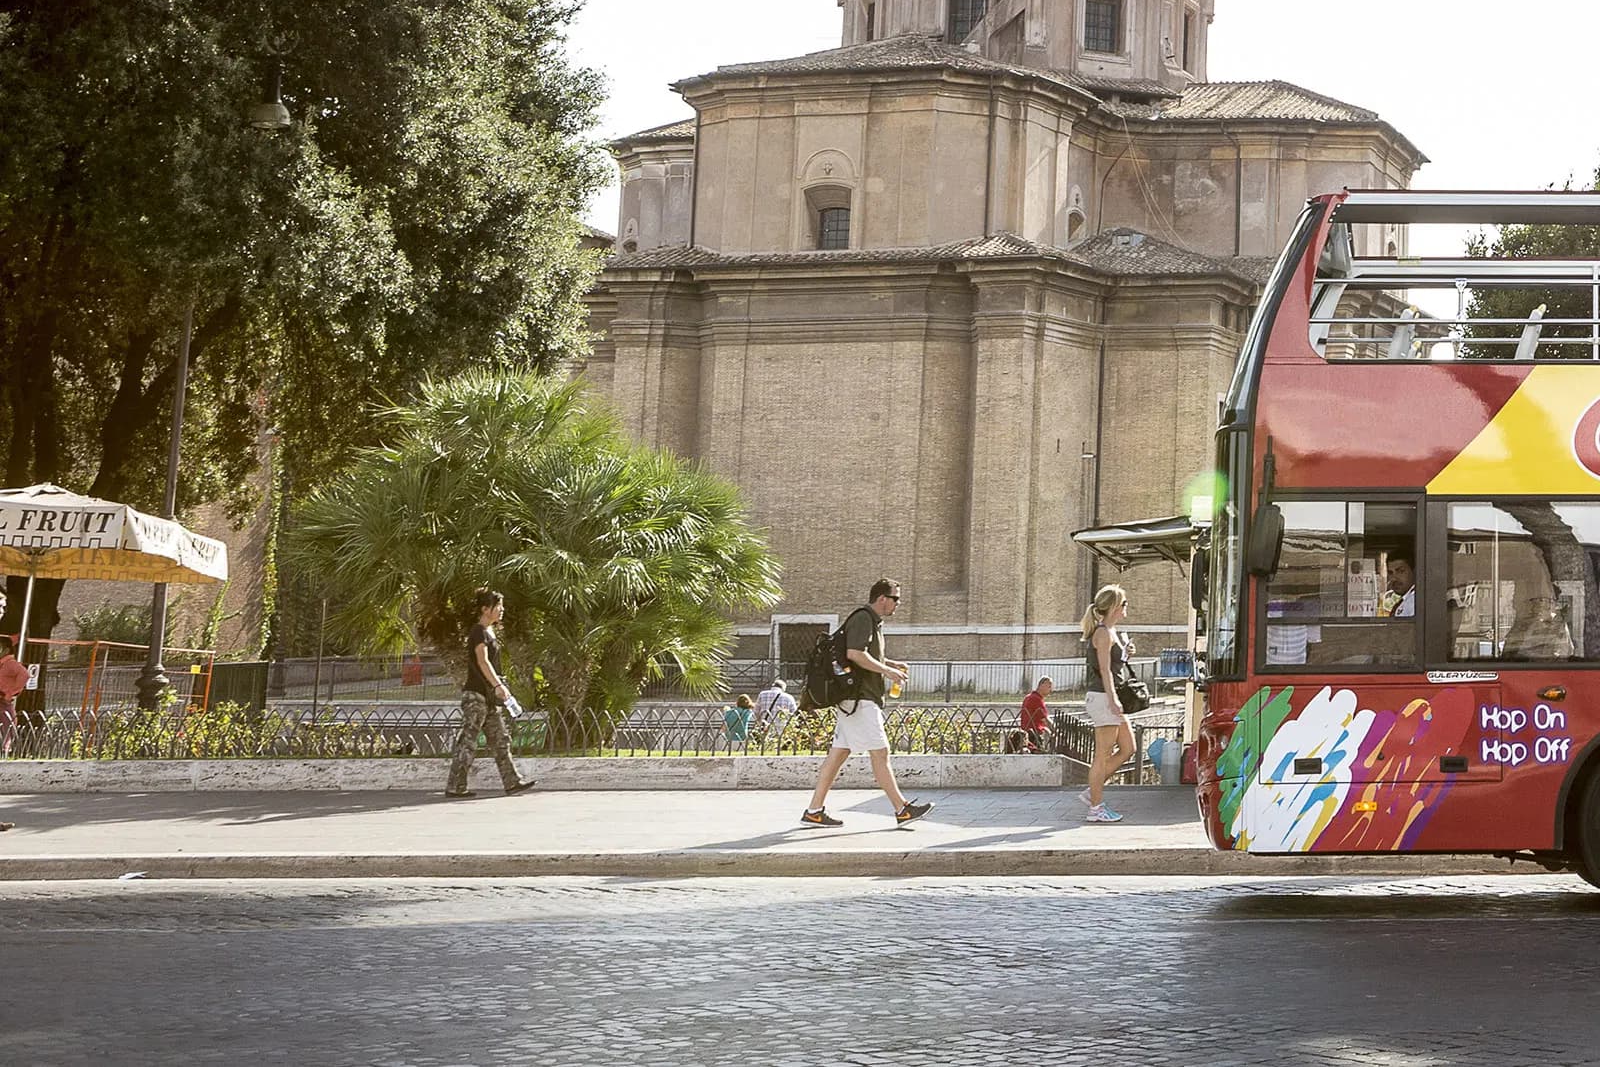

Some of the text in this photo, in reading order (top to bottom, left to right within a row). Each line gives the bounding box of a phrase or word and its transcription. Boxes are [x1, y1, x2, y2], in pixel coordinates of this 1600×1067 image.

[16, 509, 115, 534] FRUIT
[1480, 703, 1565, 733] Hop On
[1481, 736, 1571, 766] Hop Off
